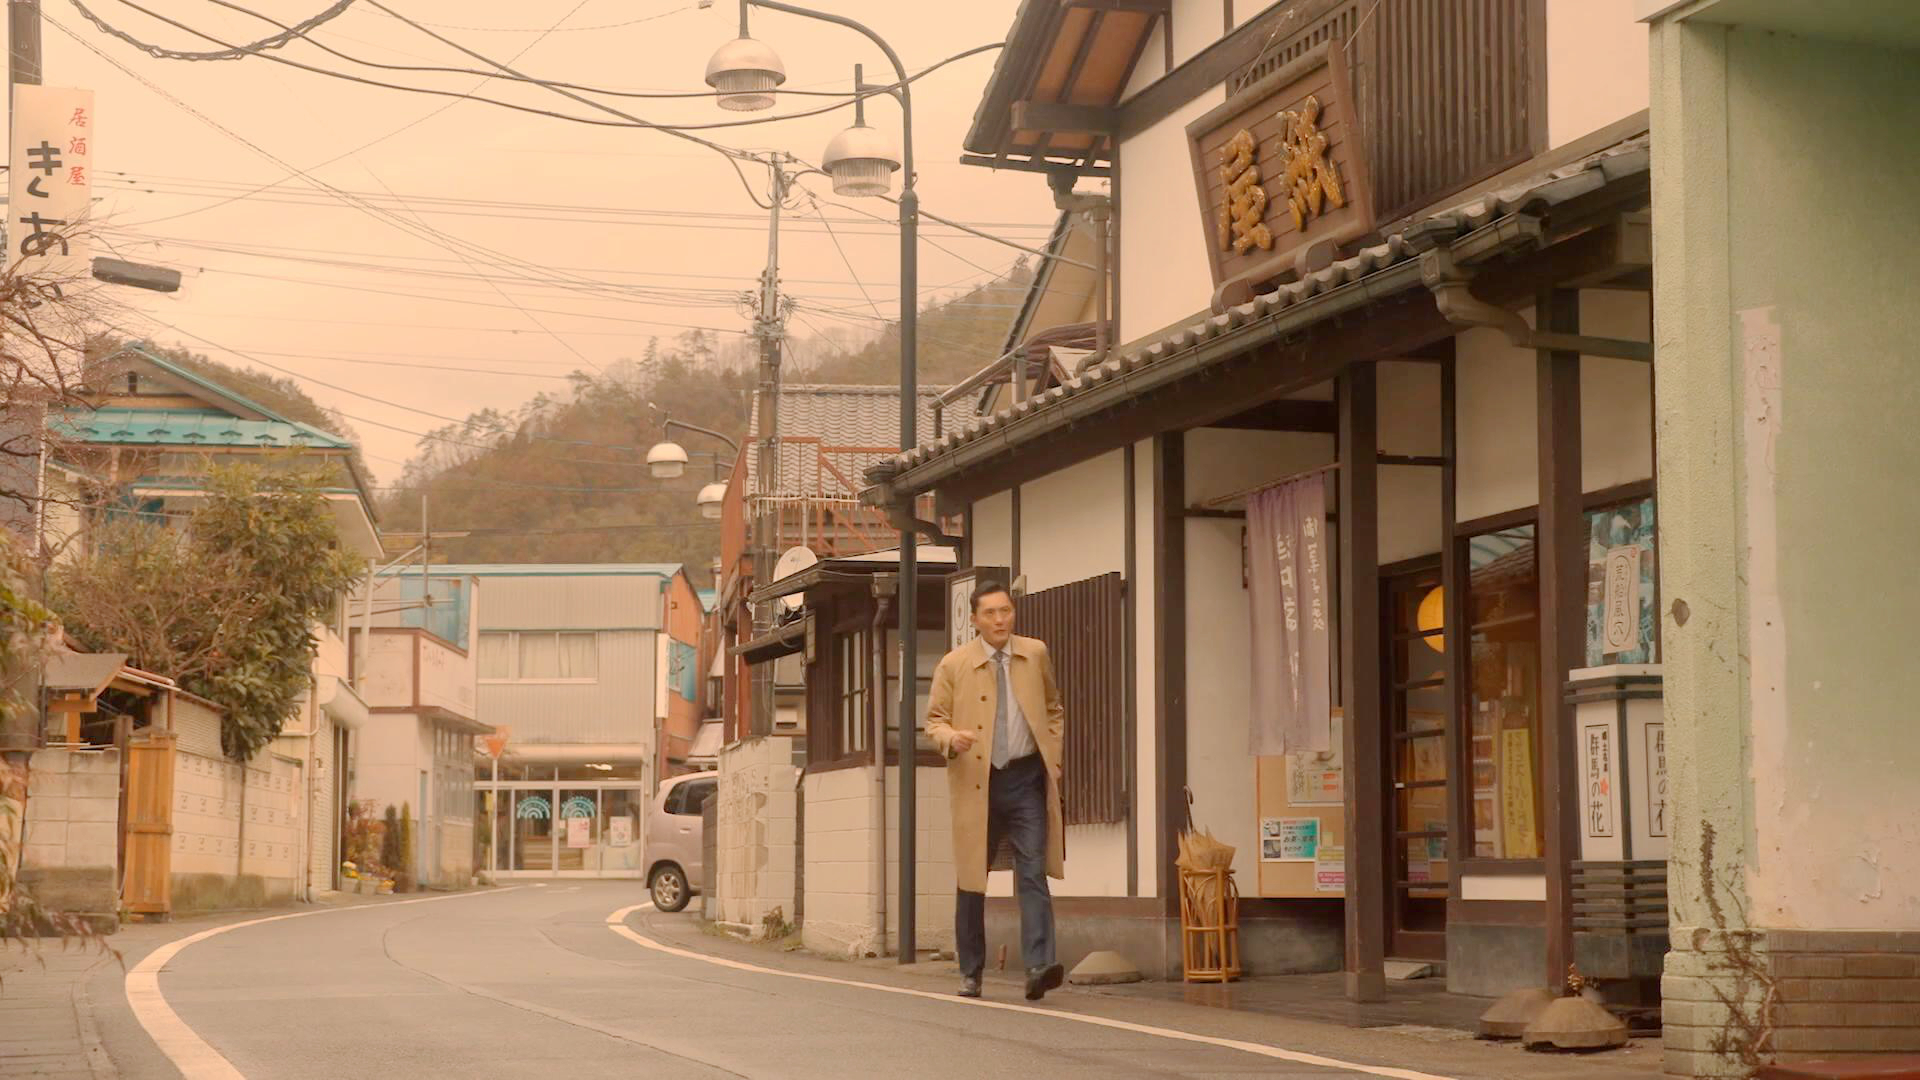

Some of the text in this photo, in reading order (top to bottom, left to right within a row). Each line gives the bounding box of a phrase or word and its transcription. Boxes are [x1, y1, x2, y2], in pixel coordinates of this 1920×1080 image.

[67, 107, 88, 186] 居酒屋
[1589, 733, 1604, 832] 群馬の花
